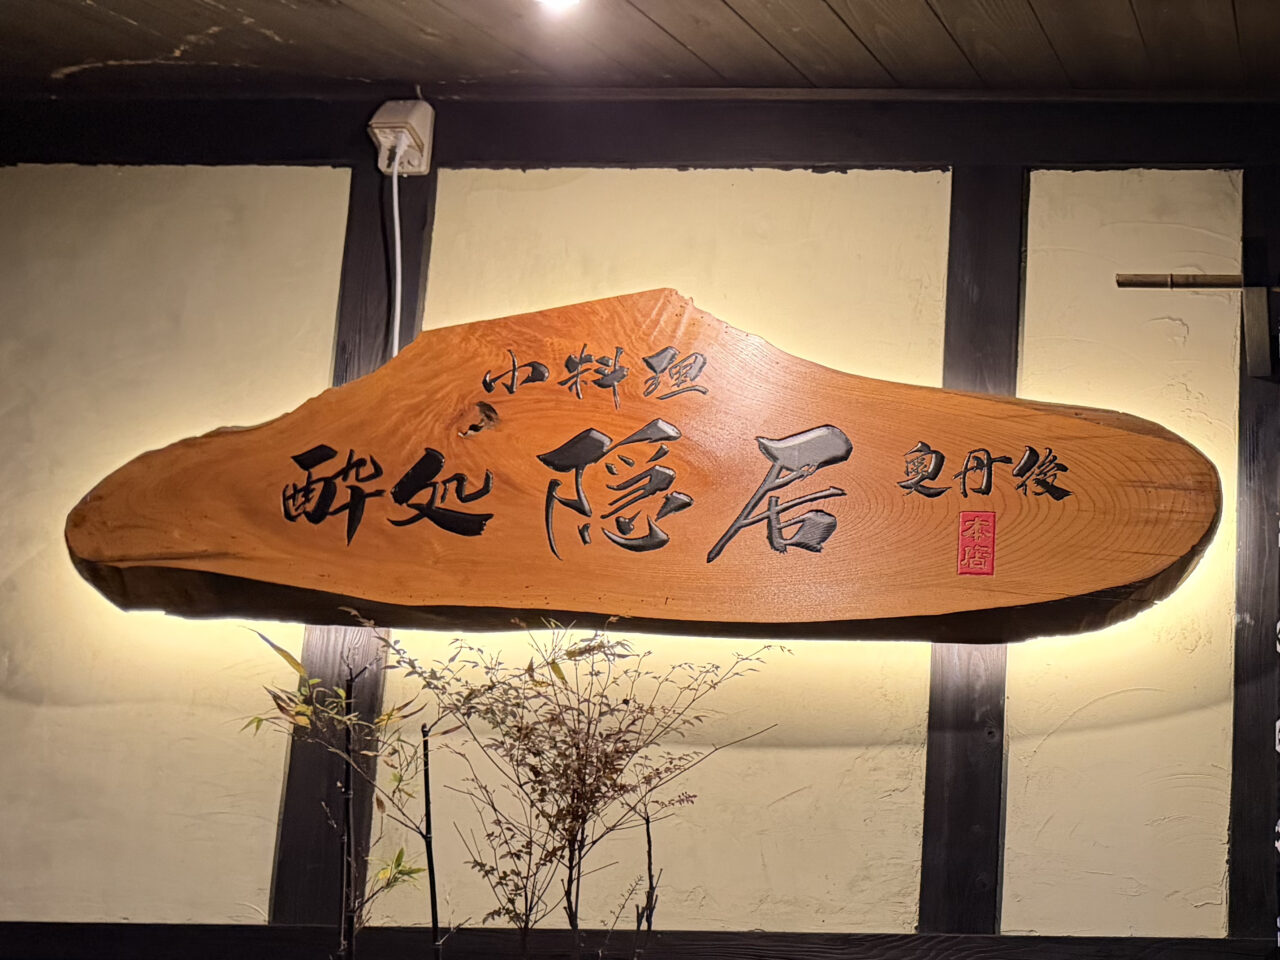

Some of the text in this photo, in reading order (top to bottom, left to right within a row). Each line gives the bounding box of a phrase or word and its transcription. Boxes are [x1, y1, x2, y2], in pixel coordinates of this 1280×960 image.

[481, 343, 709, 410] 小料理
[536, 417, 853, 563] 隠居
[897, 440, 1072, 501] 奥丹後
[961, 515, 992, 570] 本店
